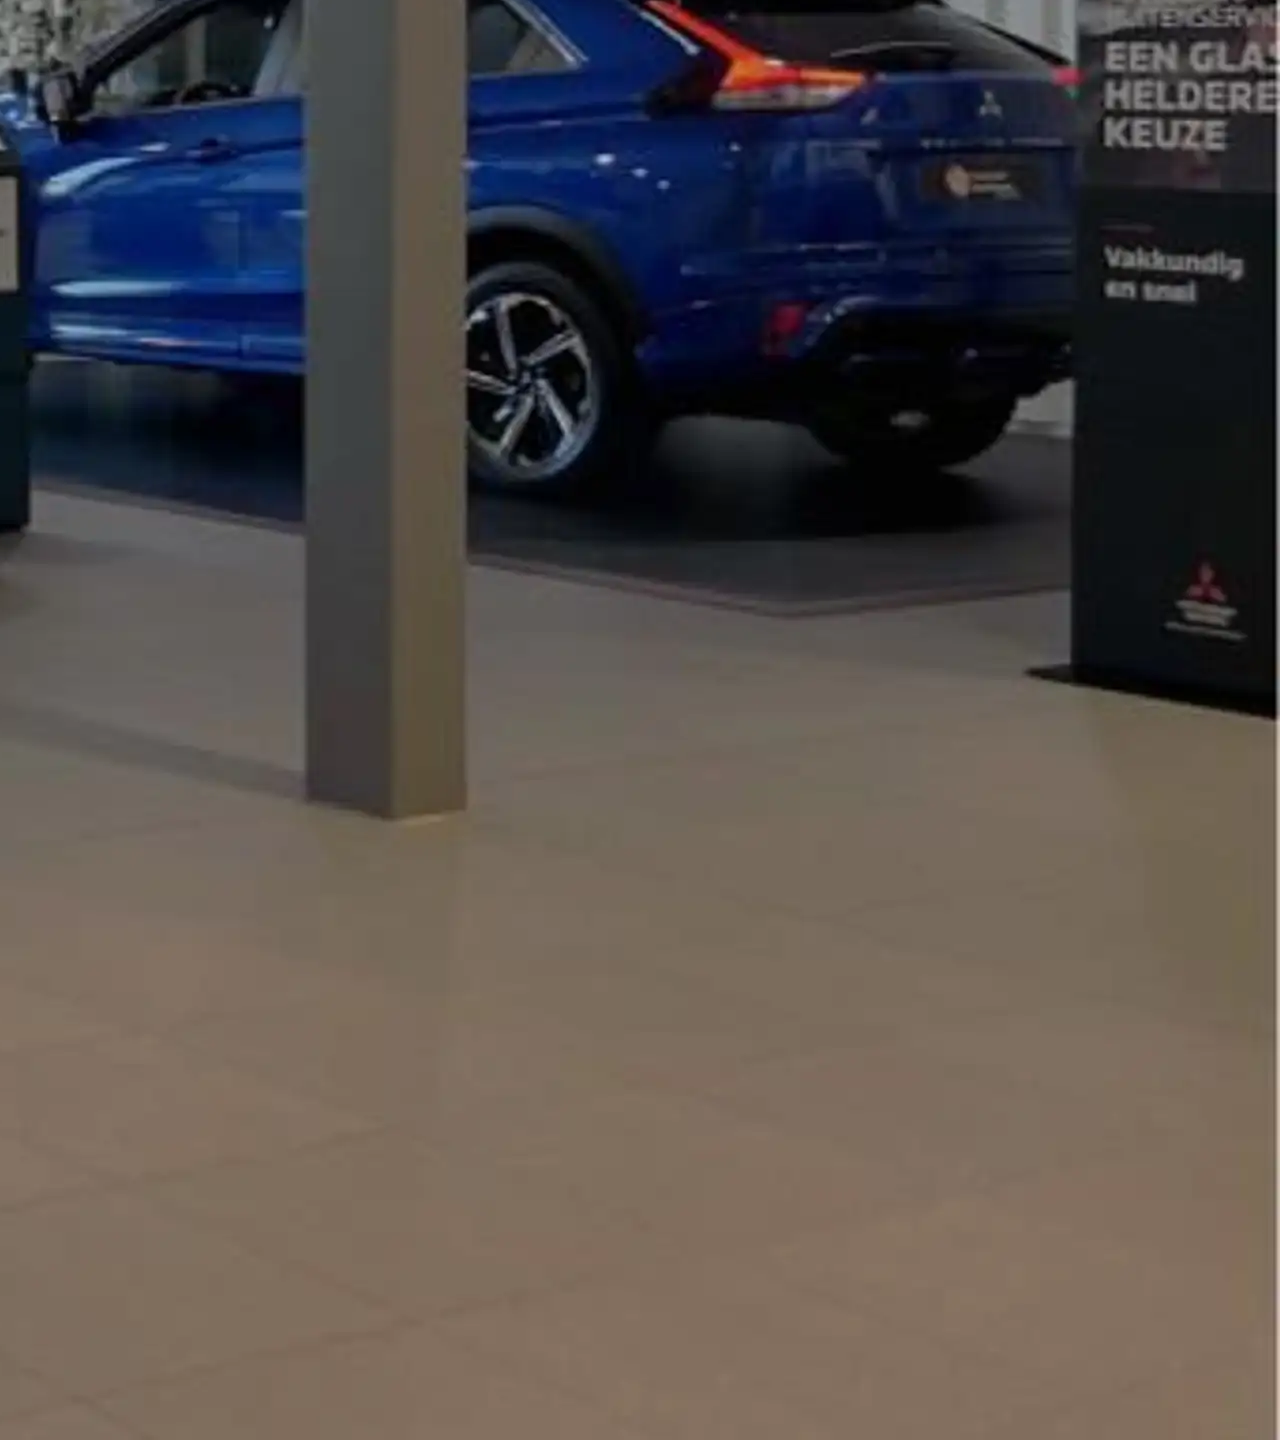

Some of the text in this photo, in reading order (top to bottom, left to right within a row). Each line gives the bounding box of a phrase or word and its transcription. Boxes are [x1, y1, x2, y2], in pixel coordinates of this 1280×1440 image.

[1105, 40, 1179, 73] EEN
[1104, 79, 1276, 114] HELDERE
[1103, 116, 1227, 151] KEUZE
[1104, 246, 1244, 282] Vakkundig
[1104, 279, 1198, 304] en snel
